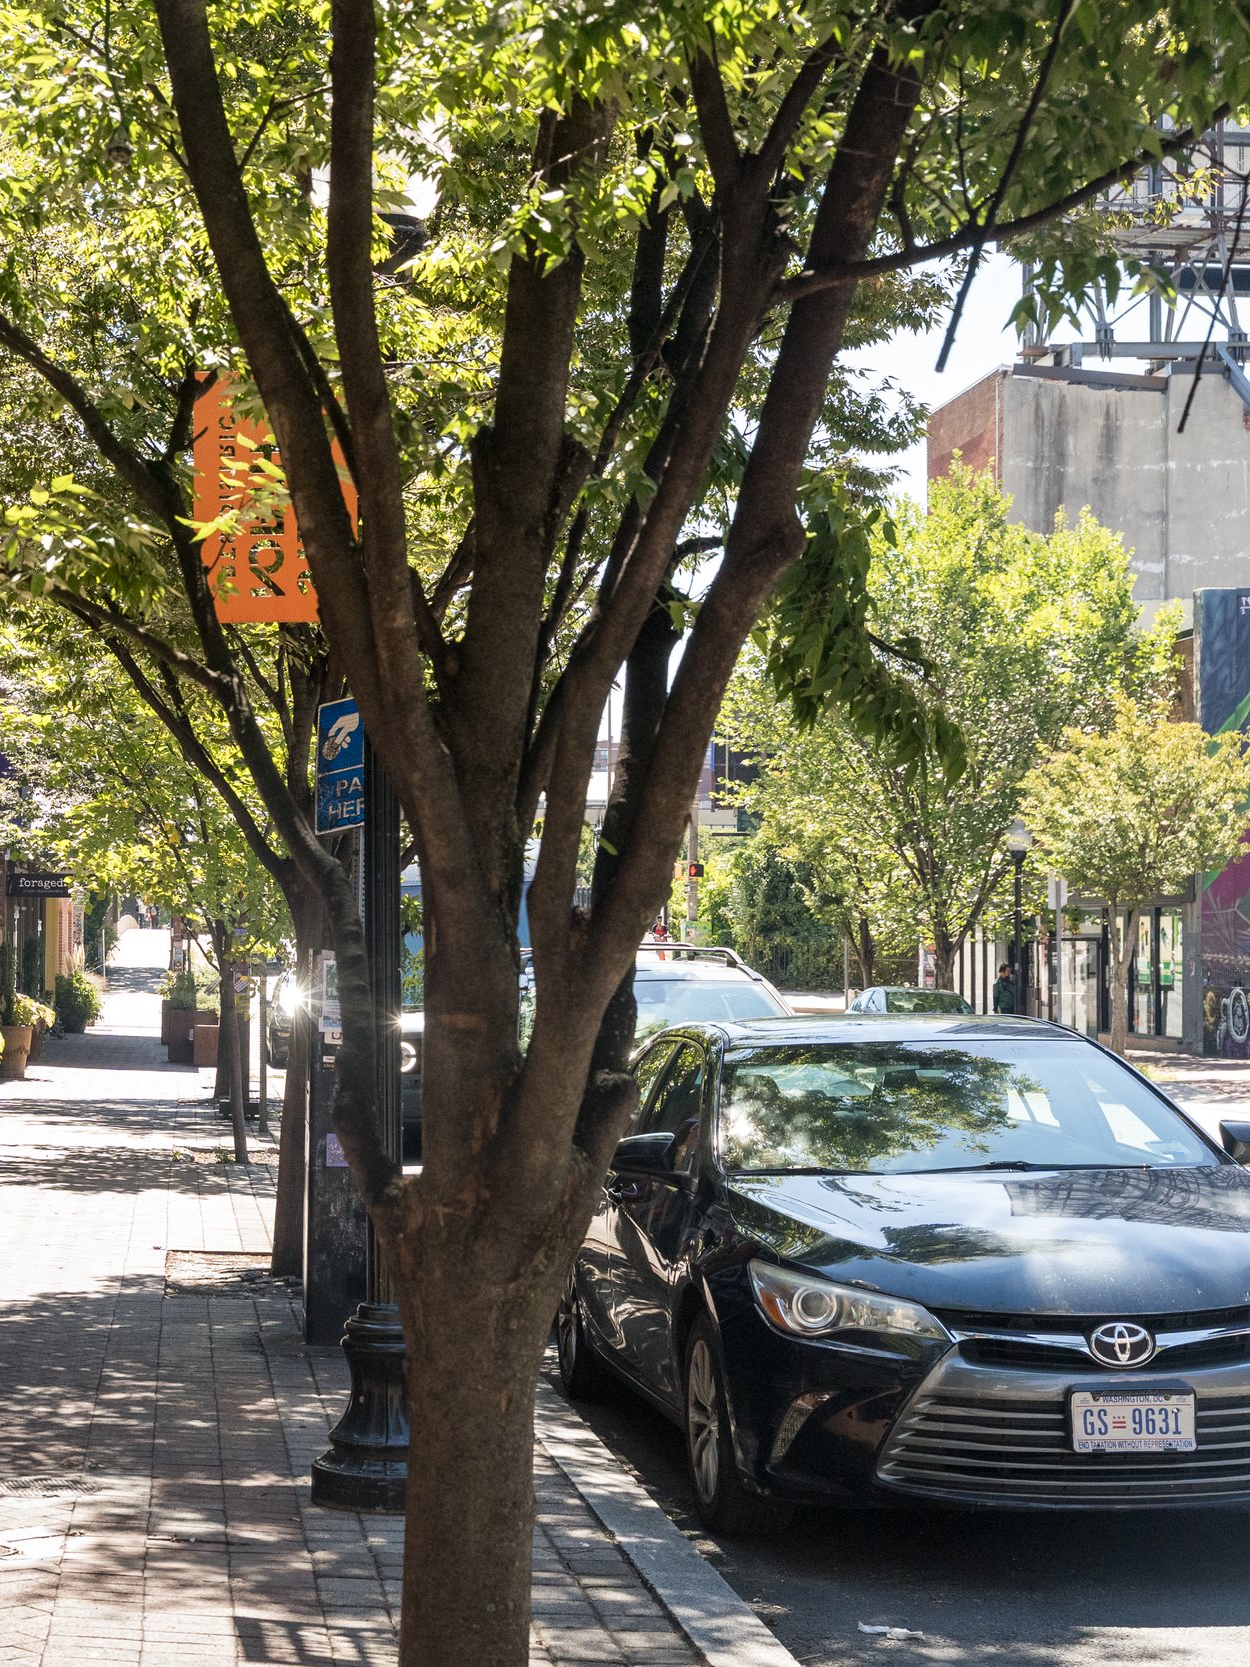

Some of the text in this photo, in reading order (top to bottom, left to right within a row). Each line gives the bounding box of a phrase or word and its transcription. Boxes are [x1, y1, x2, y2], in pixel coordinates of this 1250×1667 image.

[336, 777, 364, 797] PA
[328, 798, 365, 819] HER
[1154, 1395, 1163, 1403] DC
[1083, 1407, 1182, 1436] GS 9631
[1078, 1441, 1089, 1449] END
[1117, 1441, 1144, 1449] WITHOUT
